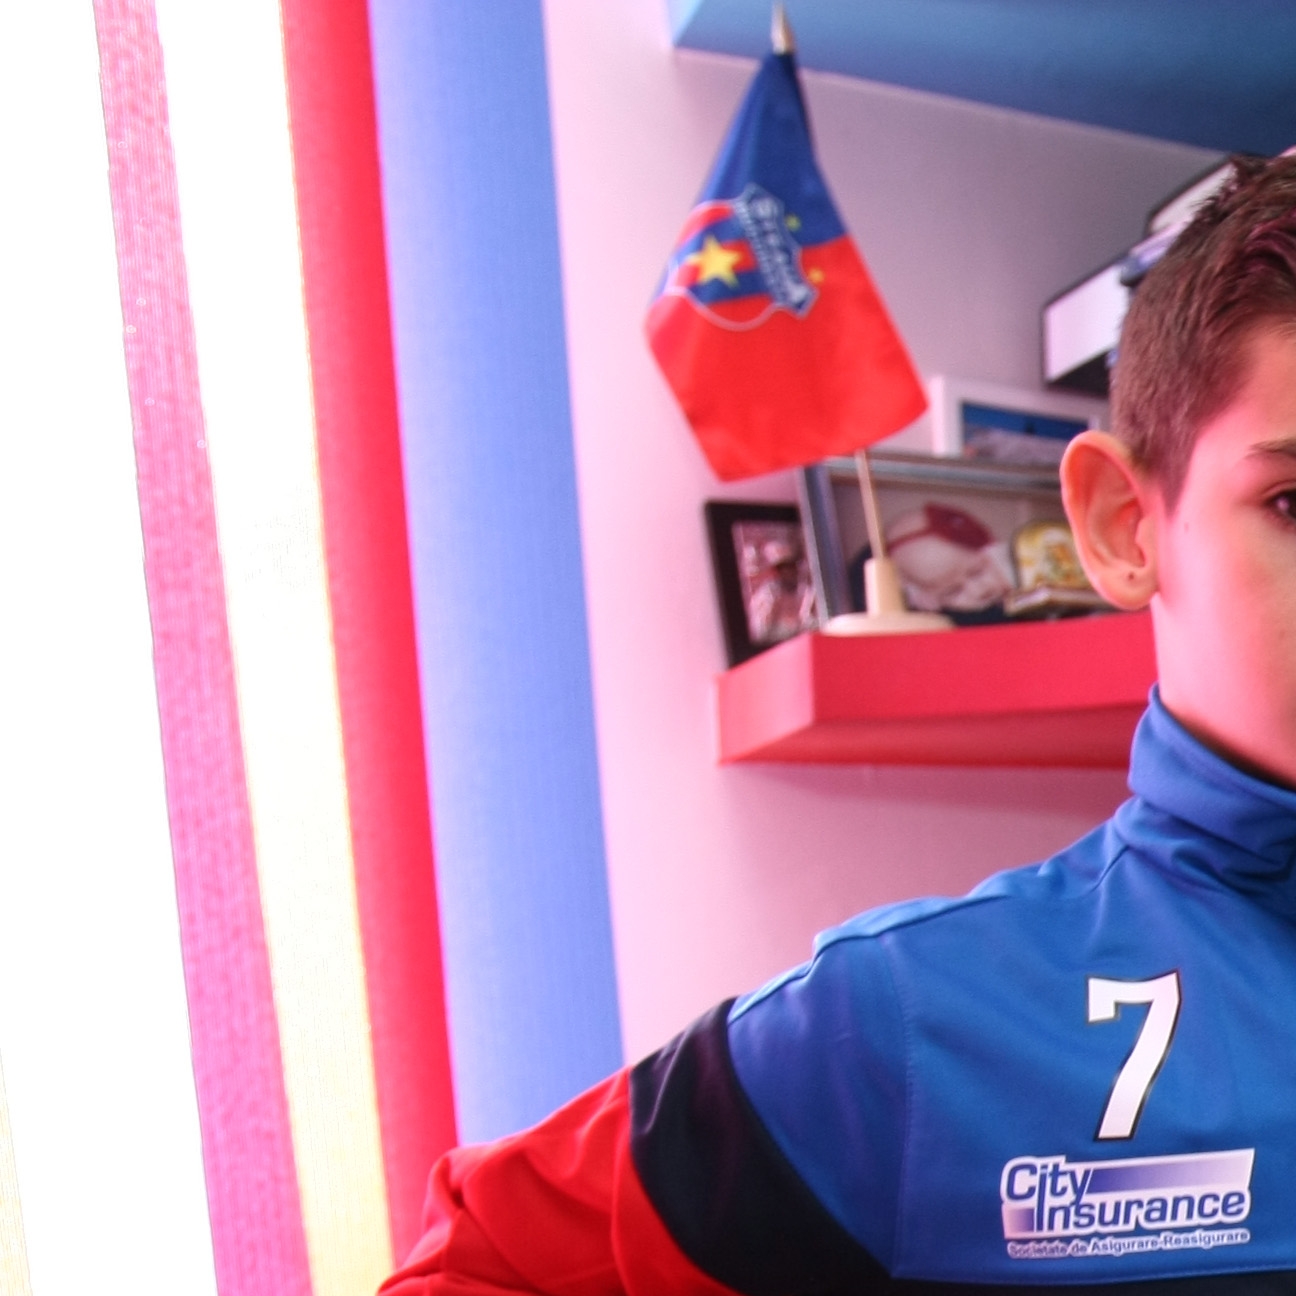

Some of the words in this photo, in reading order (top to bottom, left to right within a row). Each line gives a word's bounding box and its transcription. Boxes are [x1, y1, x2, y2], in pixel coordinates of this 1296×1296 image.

[1086, 970, 1181, 1141] 7
[1006, 1162, 1093, 1206] City
[1036, 1189, 1246, 1233] Insurance
